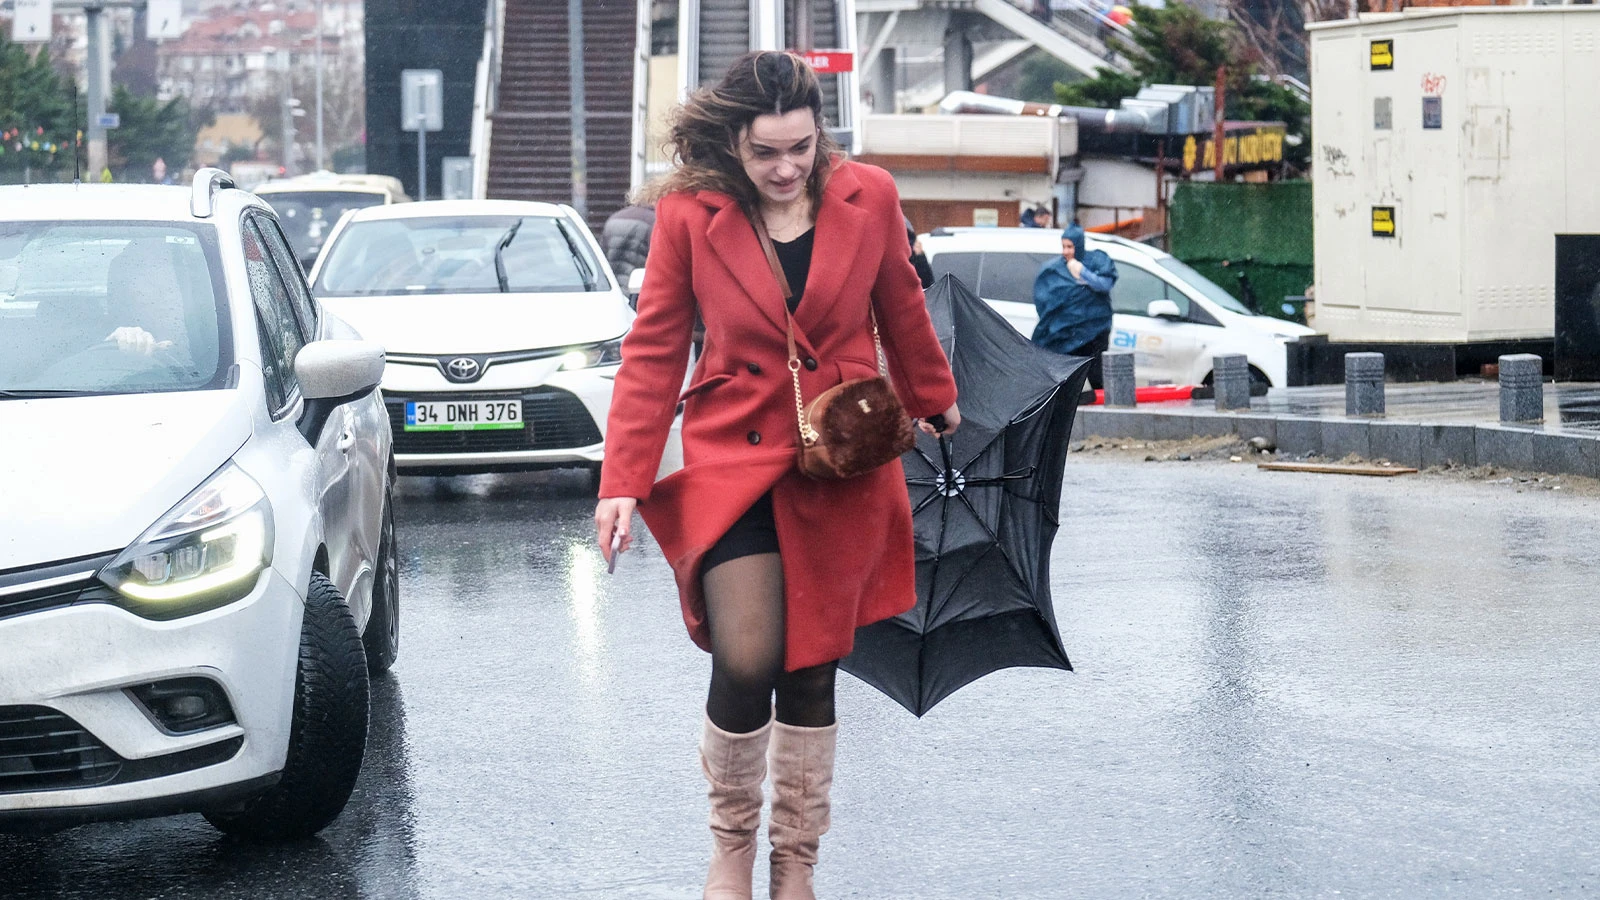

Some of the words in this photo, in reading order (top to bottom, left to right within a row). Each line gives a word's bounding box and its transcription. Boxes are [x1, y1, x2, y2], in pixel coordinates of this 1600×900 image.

[417, 404, 438, 423] 34
[447, 404, 478, 422] DNH
[485, 402, 517, 421] 376
